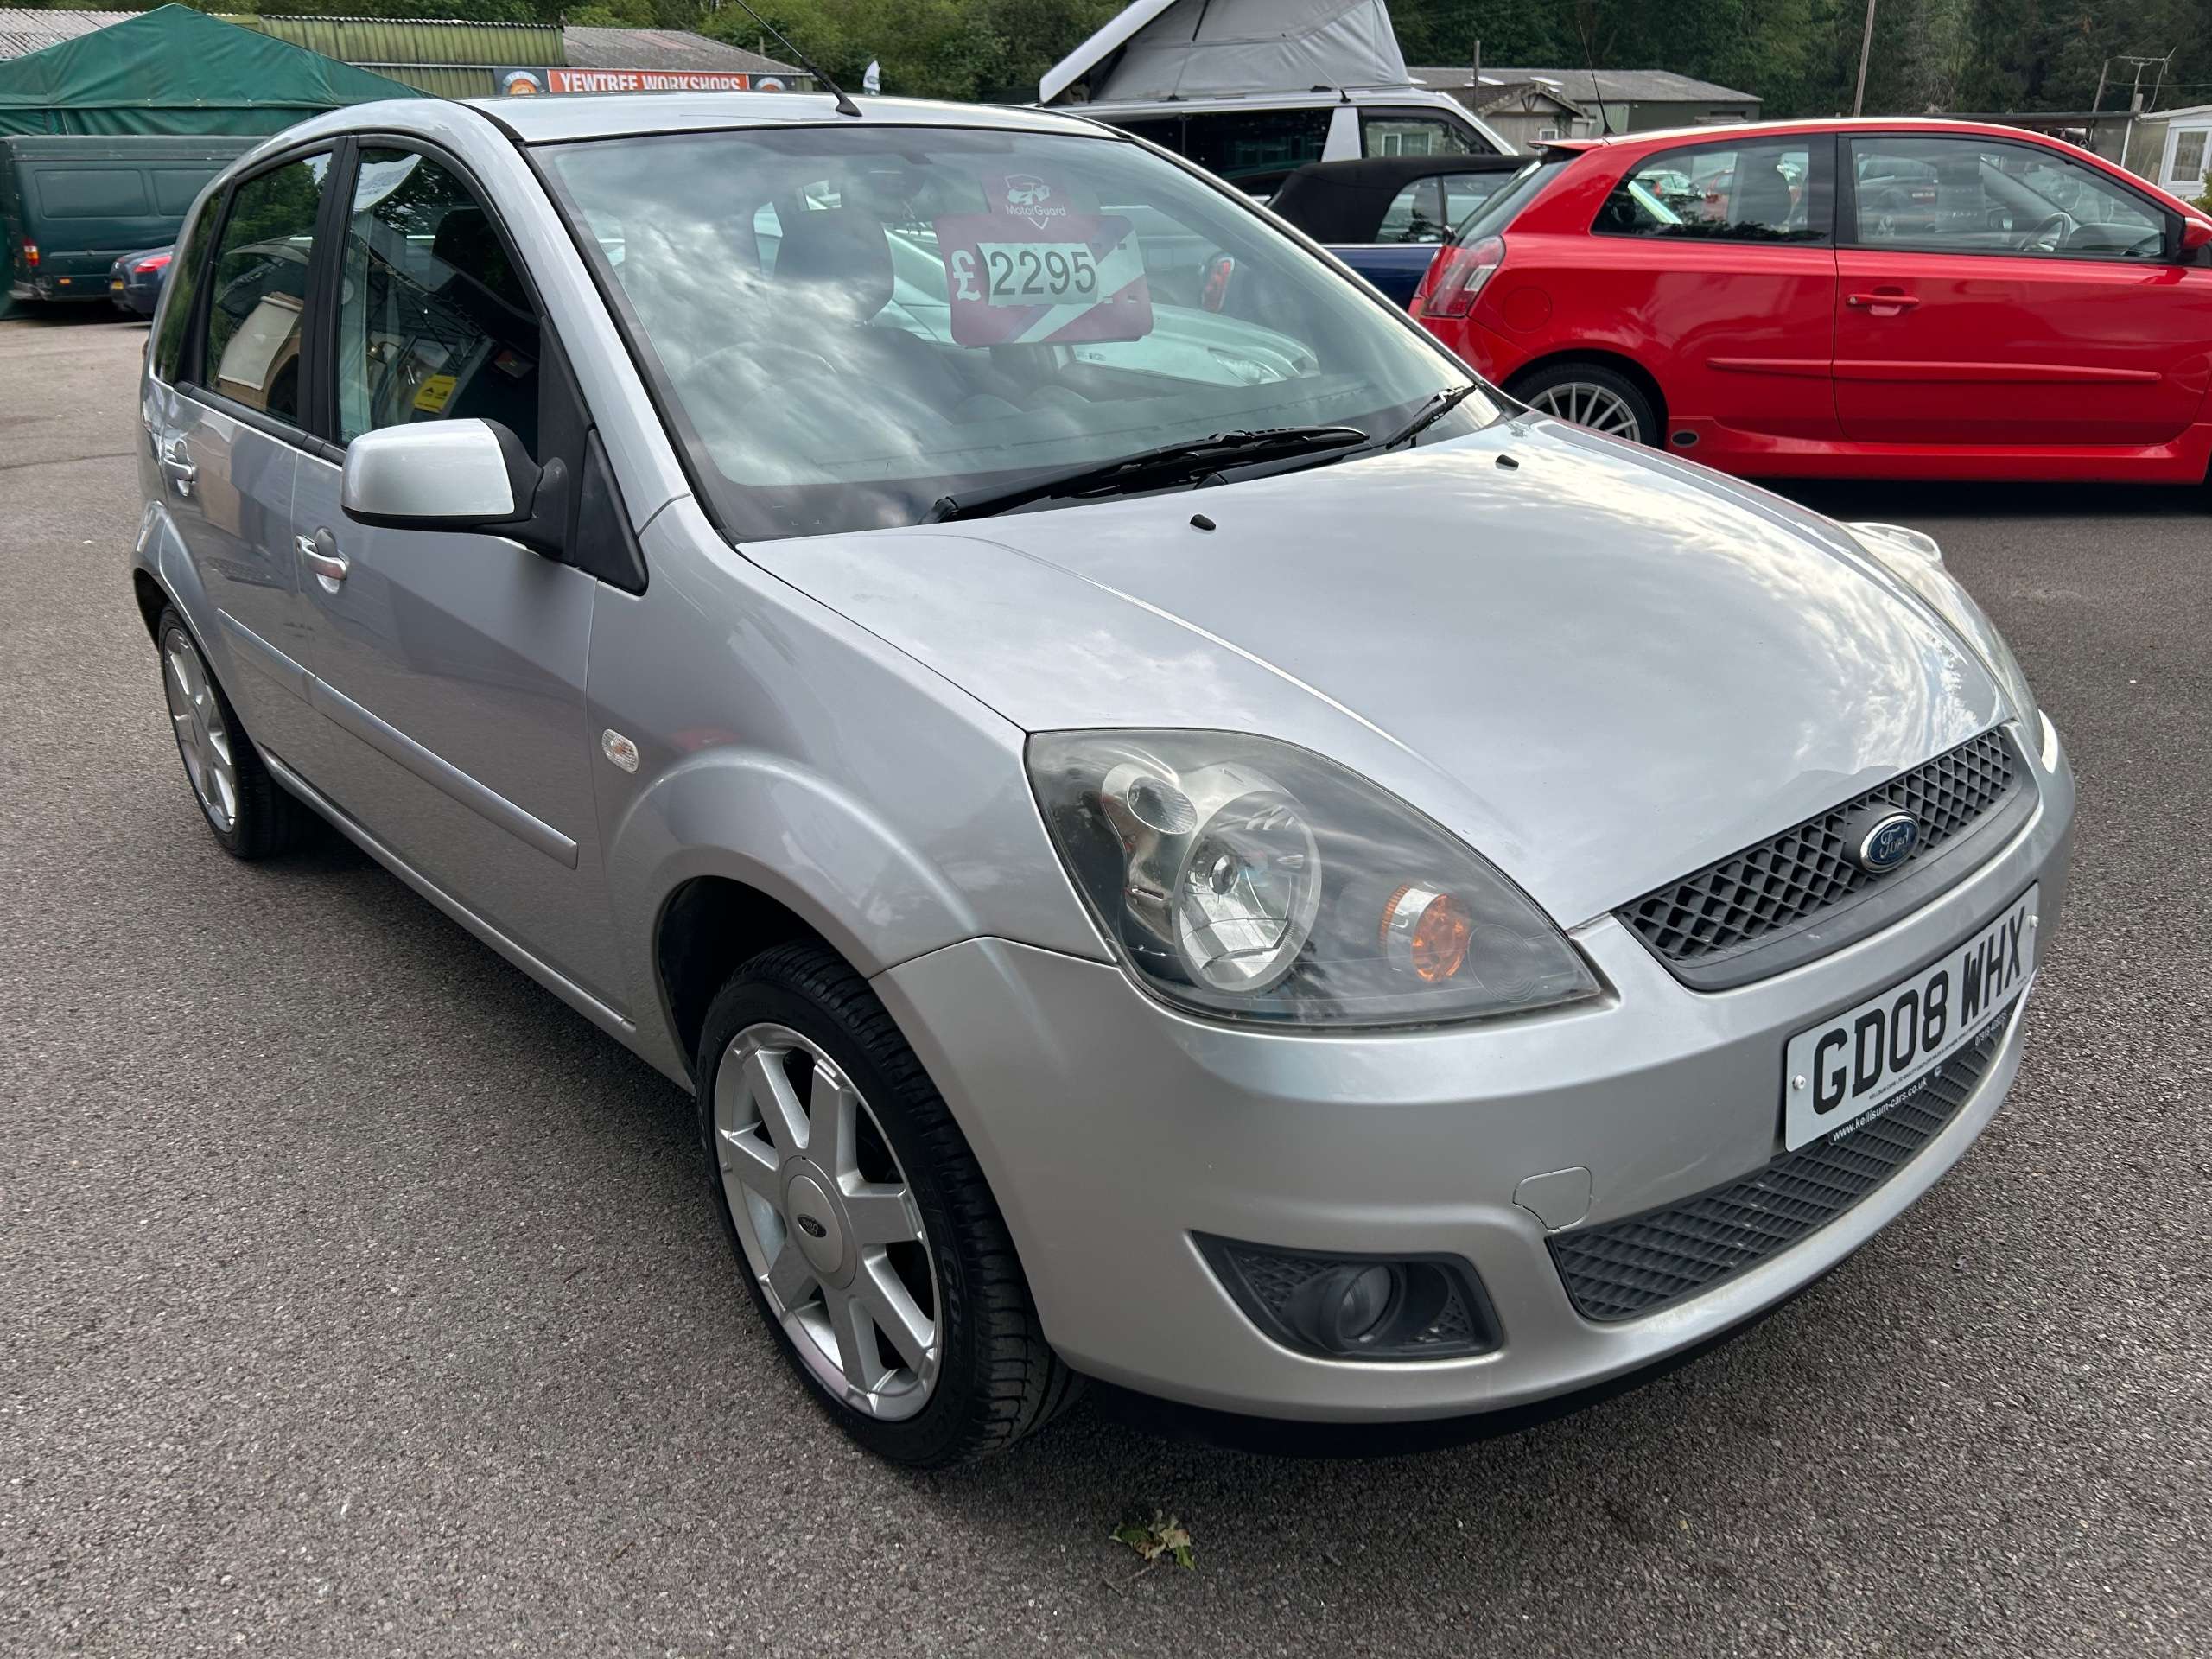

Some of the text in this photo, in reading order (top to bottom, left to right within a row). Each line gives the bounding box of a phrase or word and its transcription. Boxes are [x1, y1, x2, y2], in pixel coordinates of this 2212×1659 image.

[559, 73, 638, 92] YEWTREE
[641, 74, 741, 91] WORKSHOPS
[1005, 205, 1066, 217] MotorGuard
[1880, 825, 1910, 859] Ford
[1813, 970, 1949, 1115] GD08
[1961, 906, 2025, 1028] WHX
[1833, 1077, 1928, 1141] www.kellisum-cars.co.uk
